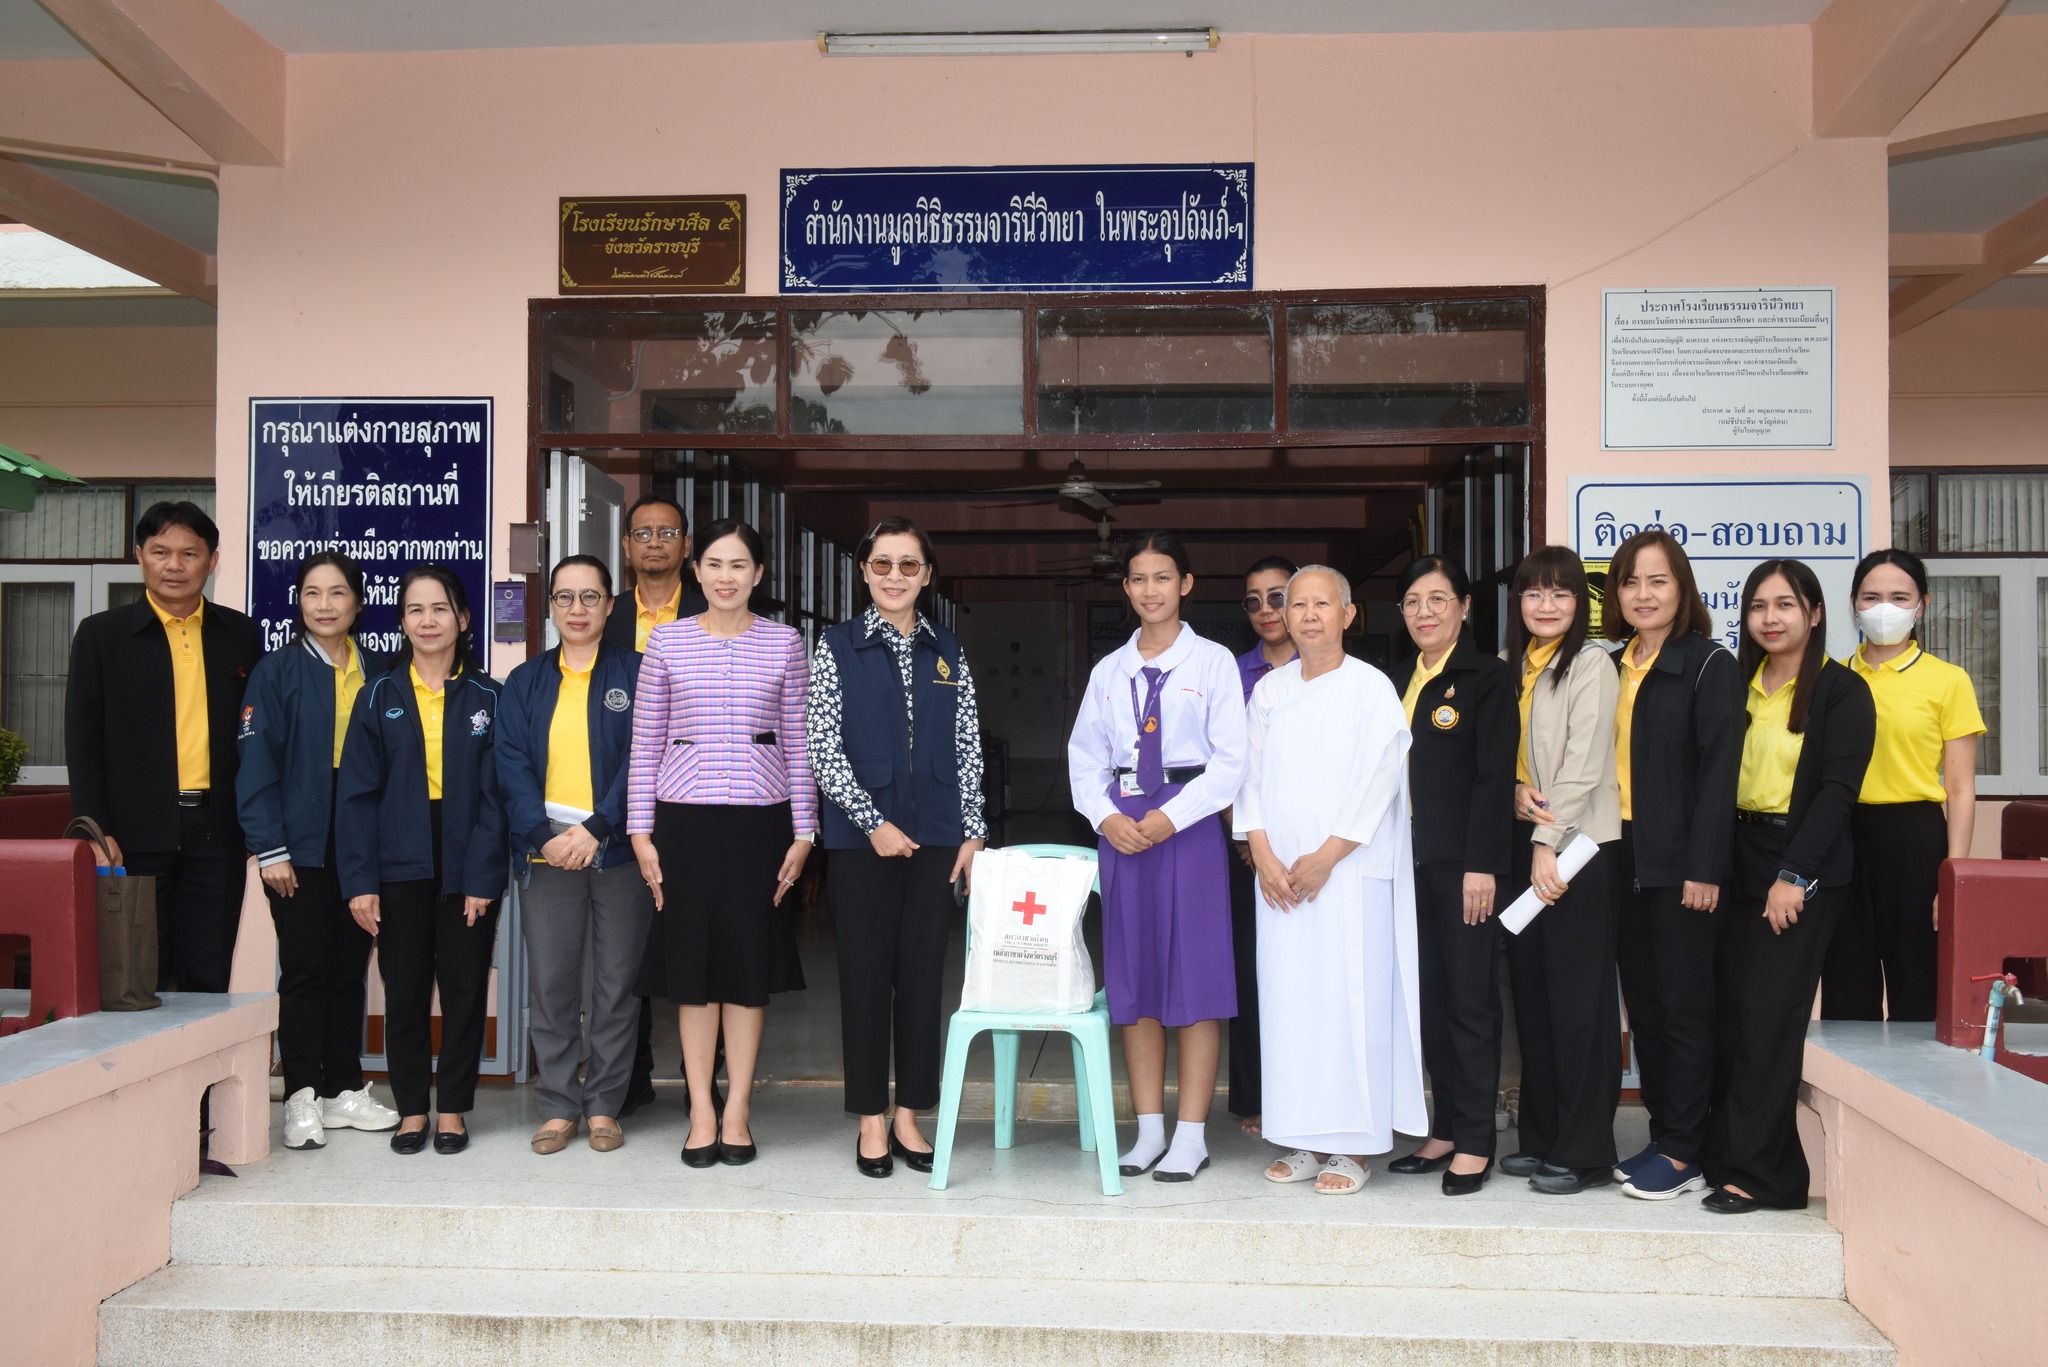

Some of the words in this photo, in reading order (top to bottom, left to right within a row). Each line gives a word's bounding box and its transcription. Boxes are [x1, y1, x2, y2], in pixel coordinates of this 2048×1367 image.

[572, 210, 711, 232] โรงเรียนรักษาศีล
[718, 217, 734, 231] ๕
[805, 191, 1084, 266] สำนักงานมูลนิธิธรรมจารินีวิทยา
[1095, 186, 1244, 263] ในพระอุปถัมภ์ฯ
[605, 237, 700, 259] จังหวัดราชบุรี
[1640, 298, 1804, 313] ประกาศโรงเรียนธรรมจารินีวิทยา
[262, 412, 481, 458] กรุณาแต่งกายสุภาพ
[283, 462, 460, 507] ให้เกียรติสถานที่
